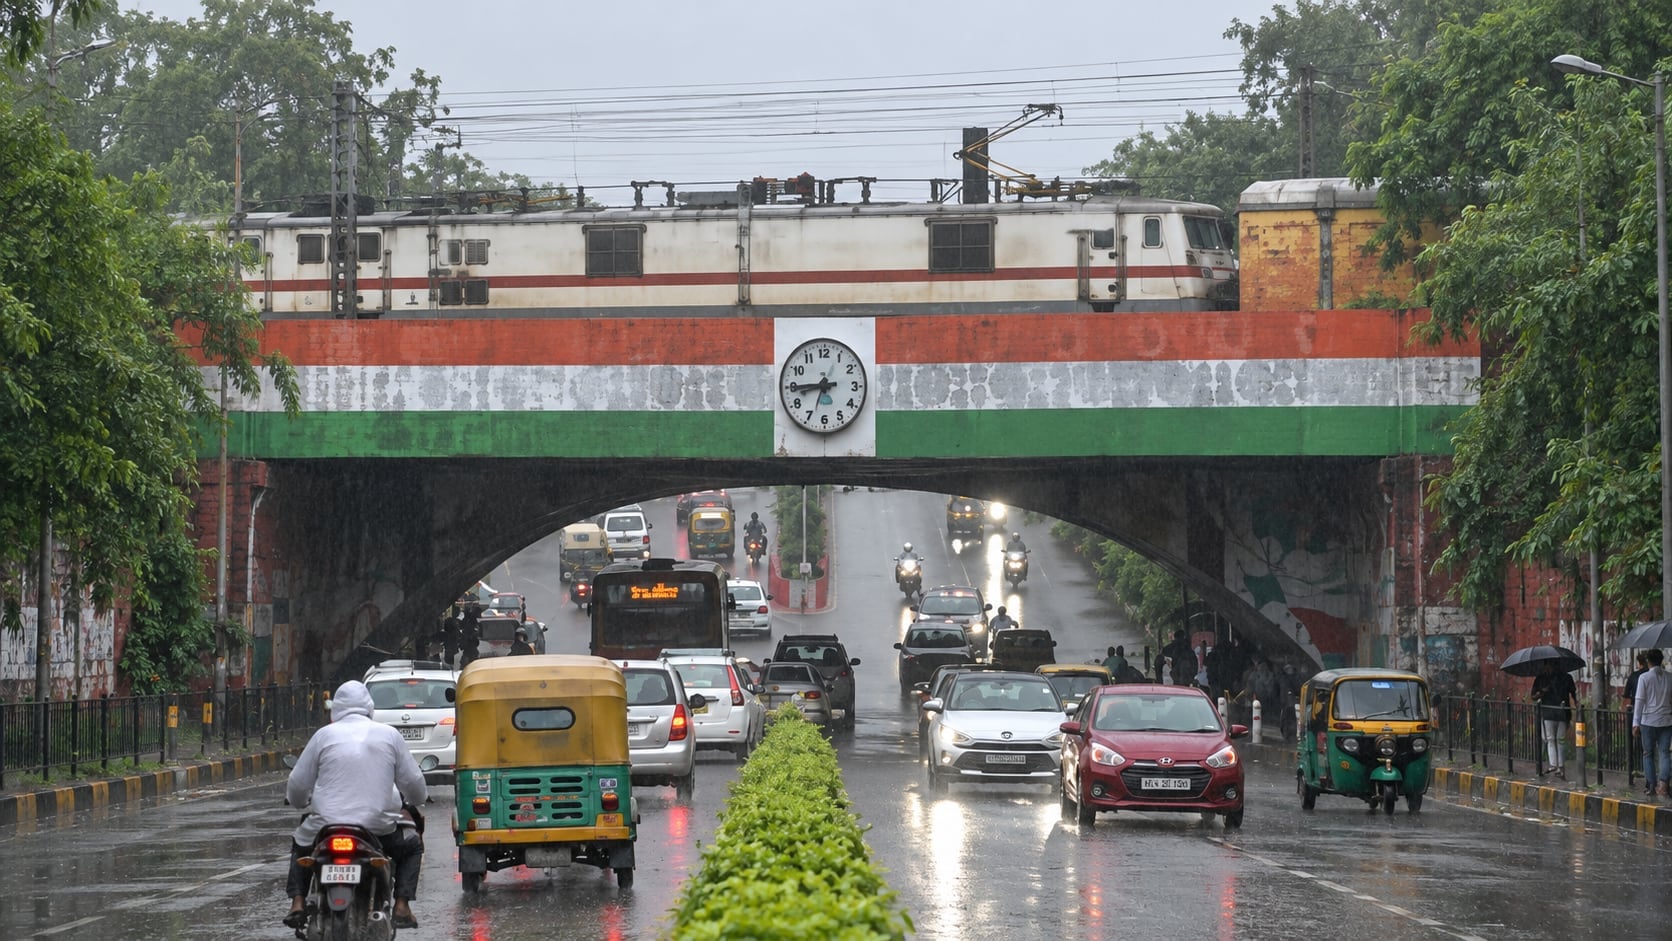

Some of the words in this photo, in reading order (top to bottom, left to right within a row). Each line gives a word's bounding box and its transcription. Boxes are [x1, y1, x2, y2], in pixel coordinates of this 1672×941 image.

[805, 353, 813, 364] 11
[818, 349, 830, 358] 12
[837, 353, 841, 363] 1
[793, 366, 804, 376] 10
[846, 364, 854, 374] 2
[851, 381, 858, 391] 3
[794, 398, 801, 409] 8
[846, 398, 854, 408] 4
[805, 410, 813, 421] 7
[821, 415, 829, 424] 6
[836, 410, 844, 421] 5
